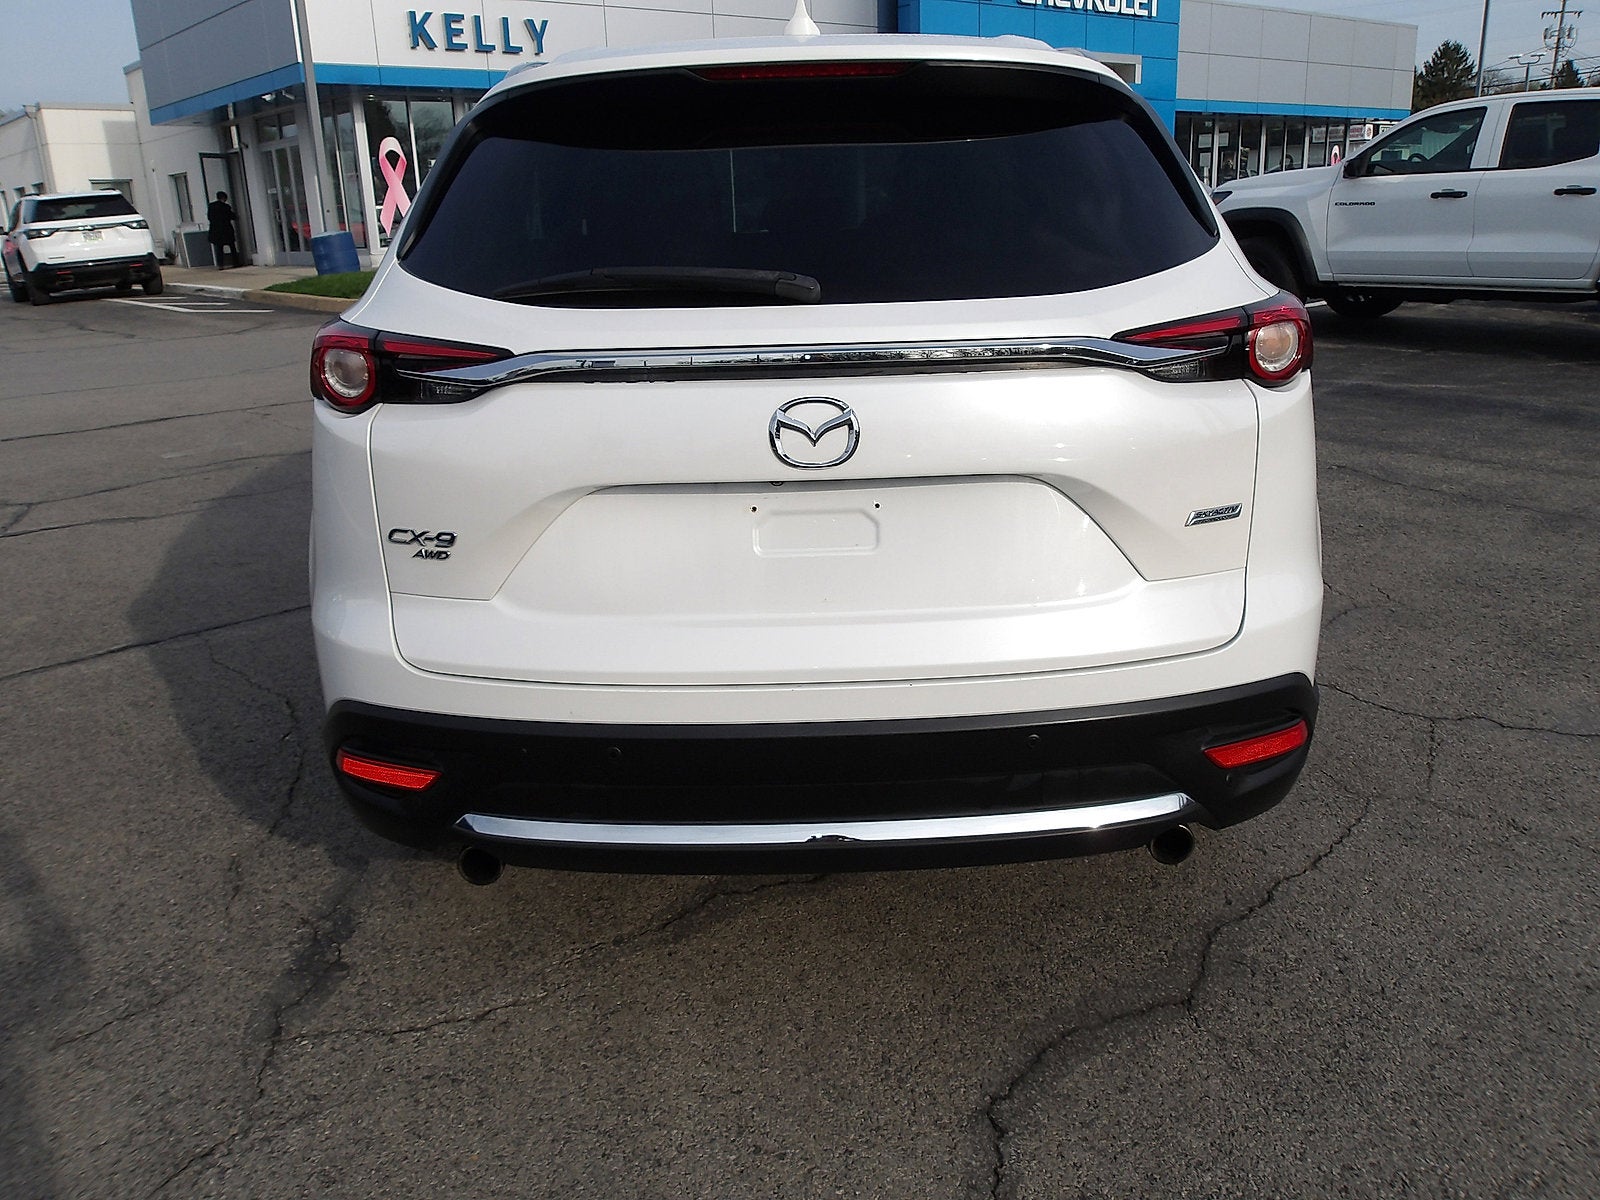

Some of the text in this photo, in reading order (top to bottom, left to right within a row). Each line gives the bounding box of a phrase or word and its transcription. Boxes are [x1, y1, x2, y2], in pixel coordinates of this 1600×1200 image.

[407, 10, 549, 55] KELLY
[388, 528, 457, 548] CX-9
[412, 548, 451, 560] AWD
